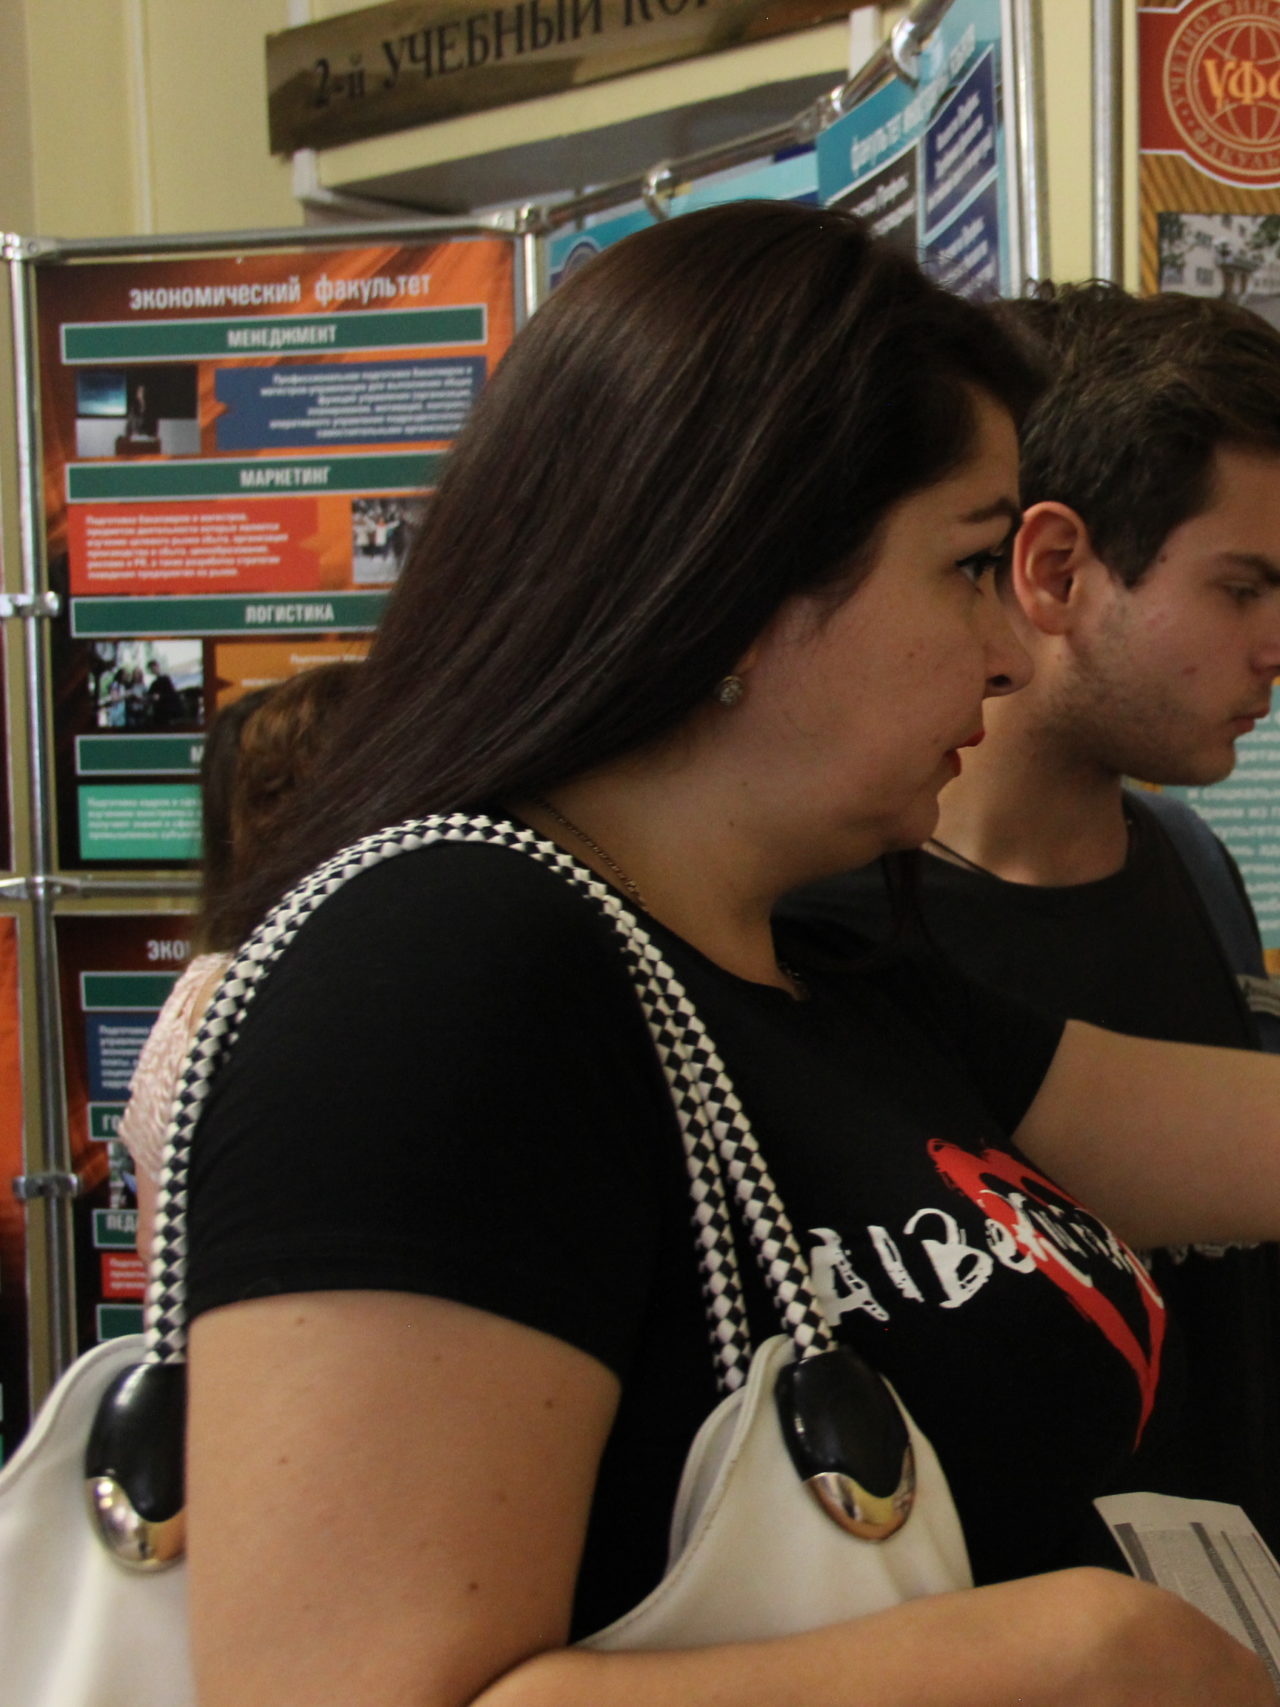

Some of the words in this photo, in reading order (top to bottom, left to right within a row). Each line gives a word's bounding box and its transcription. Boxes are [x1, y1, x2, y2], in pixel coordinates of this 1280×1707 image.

[382, 0, 601, 89] УЧЕБНЫЙ
[129, 276, 301, 311] экономический
[314, 273, 432, 306] факультет
[227, 324, 337, 349] МЕНЕДЖМЕНТ
[240, 466, 331, 487] МАРКЕТИНГ
[245, 603, 335, 624] ЛОГИСТИКА
